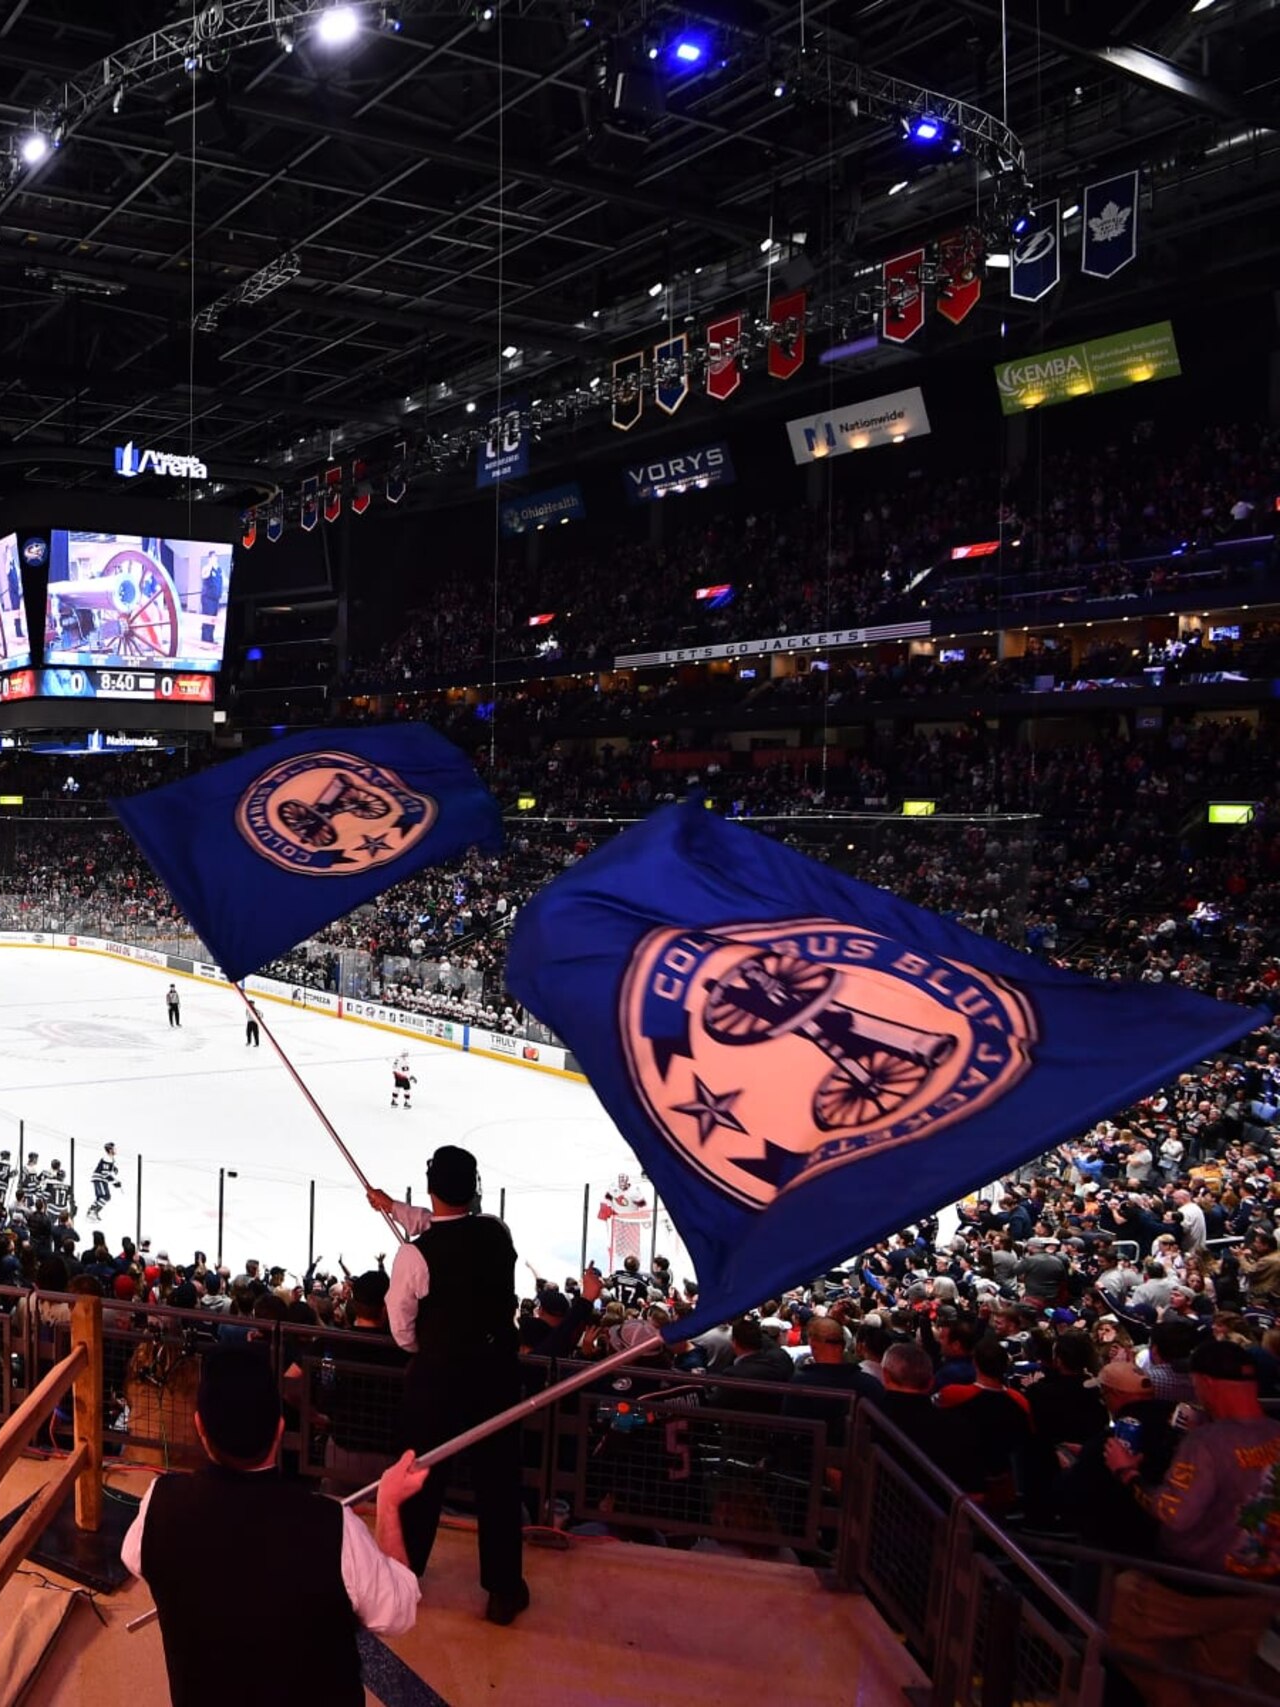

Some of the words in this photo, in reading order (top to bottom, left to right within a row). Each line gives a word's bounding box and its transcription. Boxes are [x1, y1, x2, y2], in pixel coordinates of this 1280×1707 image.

[1010, 354, 1082, 386] KEMBA
[838, 408, 906, 434] Nationwide
[137, 450, 208, 479] Arena
[628, 447, 724, 485] VORYS
[520, 494, 579, 521] OhioHealth
[664, 648, 713, 663] LET'S
[726, 643, 749, 655] GO
[759, 630, 859, 652] JACKETS
[70, 672, 83, 693] 0
[100, 673, 135, 691] 8:40
[161, 676, 173, 697] 0
[106, 734, 159, 747] Nationwide
[250, 785, 312, 864] COLUMBUS
[489, 1033, 517, 1049] TRULY
[55, 1189, 67, 1206] 17
[618, 1284, 636, 1304] 17
[664, 1419, 690, 1480] 5
